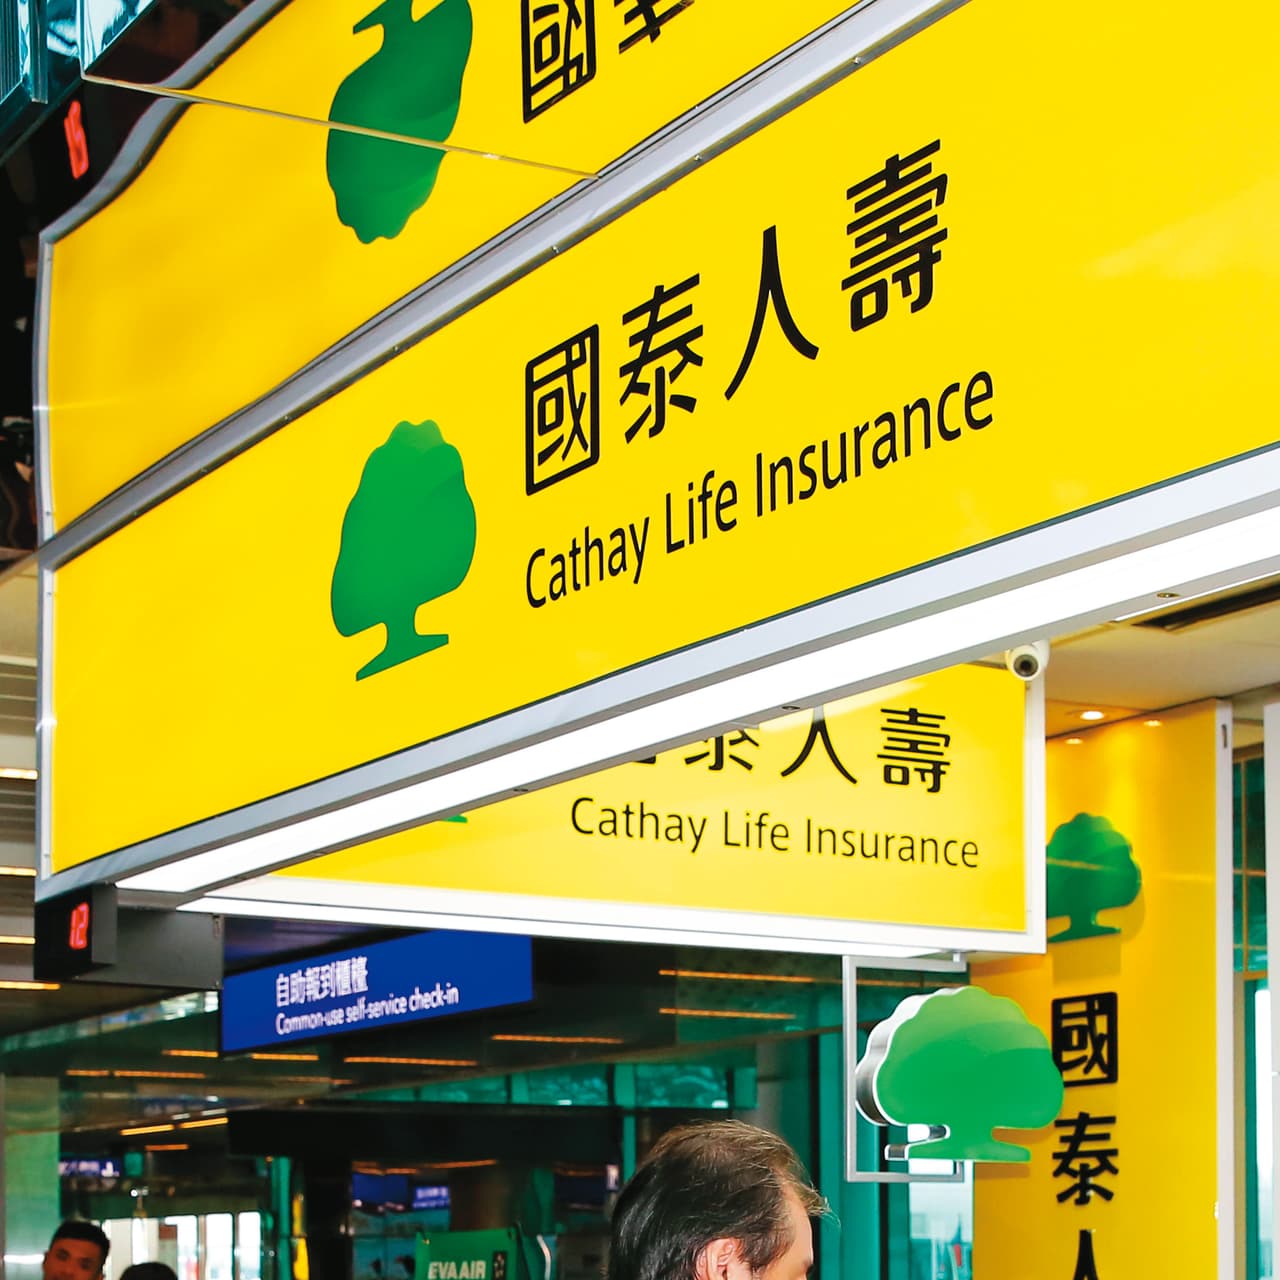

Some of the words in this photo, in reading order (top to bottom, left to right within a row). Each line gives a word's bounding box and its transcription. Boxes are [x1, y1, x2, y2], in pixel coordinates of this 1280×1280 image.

[524, 138, 949, 497] 國泰人壽
[525, 515, 651, 609] Cathay
[665, 470, 738, 554] Life
[756, 370, 994, 517] Insurance
[634, 704, 951, 794] 人壽
[569, 794, 707, 854] Cathay
[723, 810, 790, 852] Life
[806, 817, 980, 868] Insurance
[275, 1006, 344, 1035] Common-use
[345, 994, 407, 1024] self-service
[409, 981, 460, 1010] check-in
